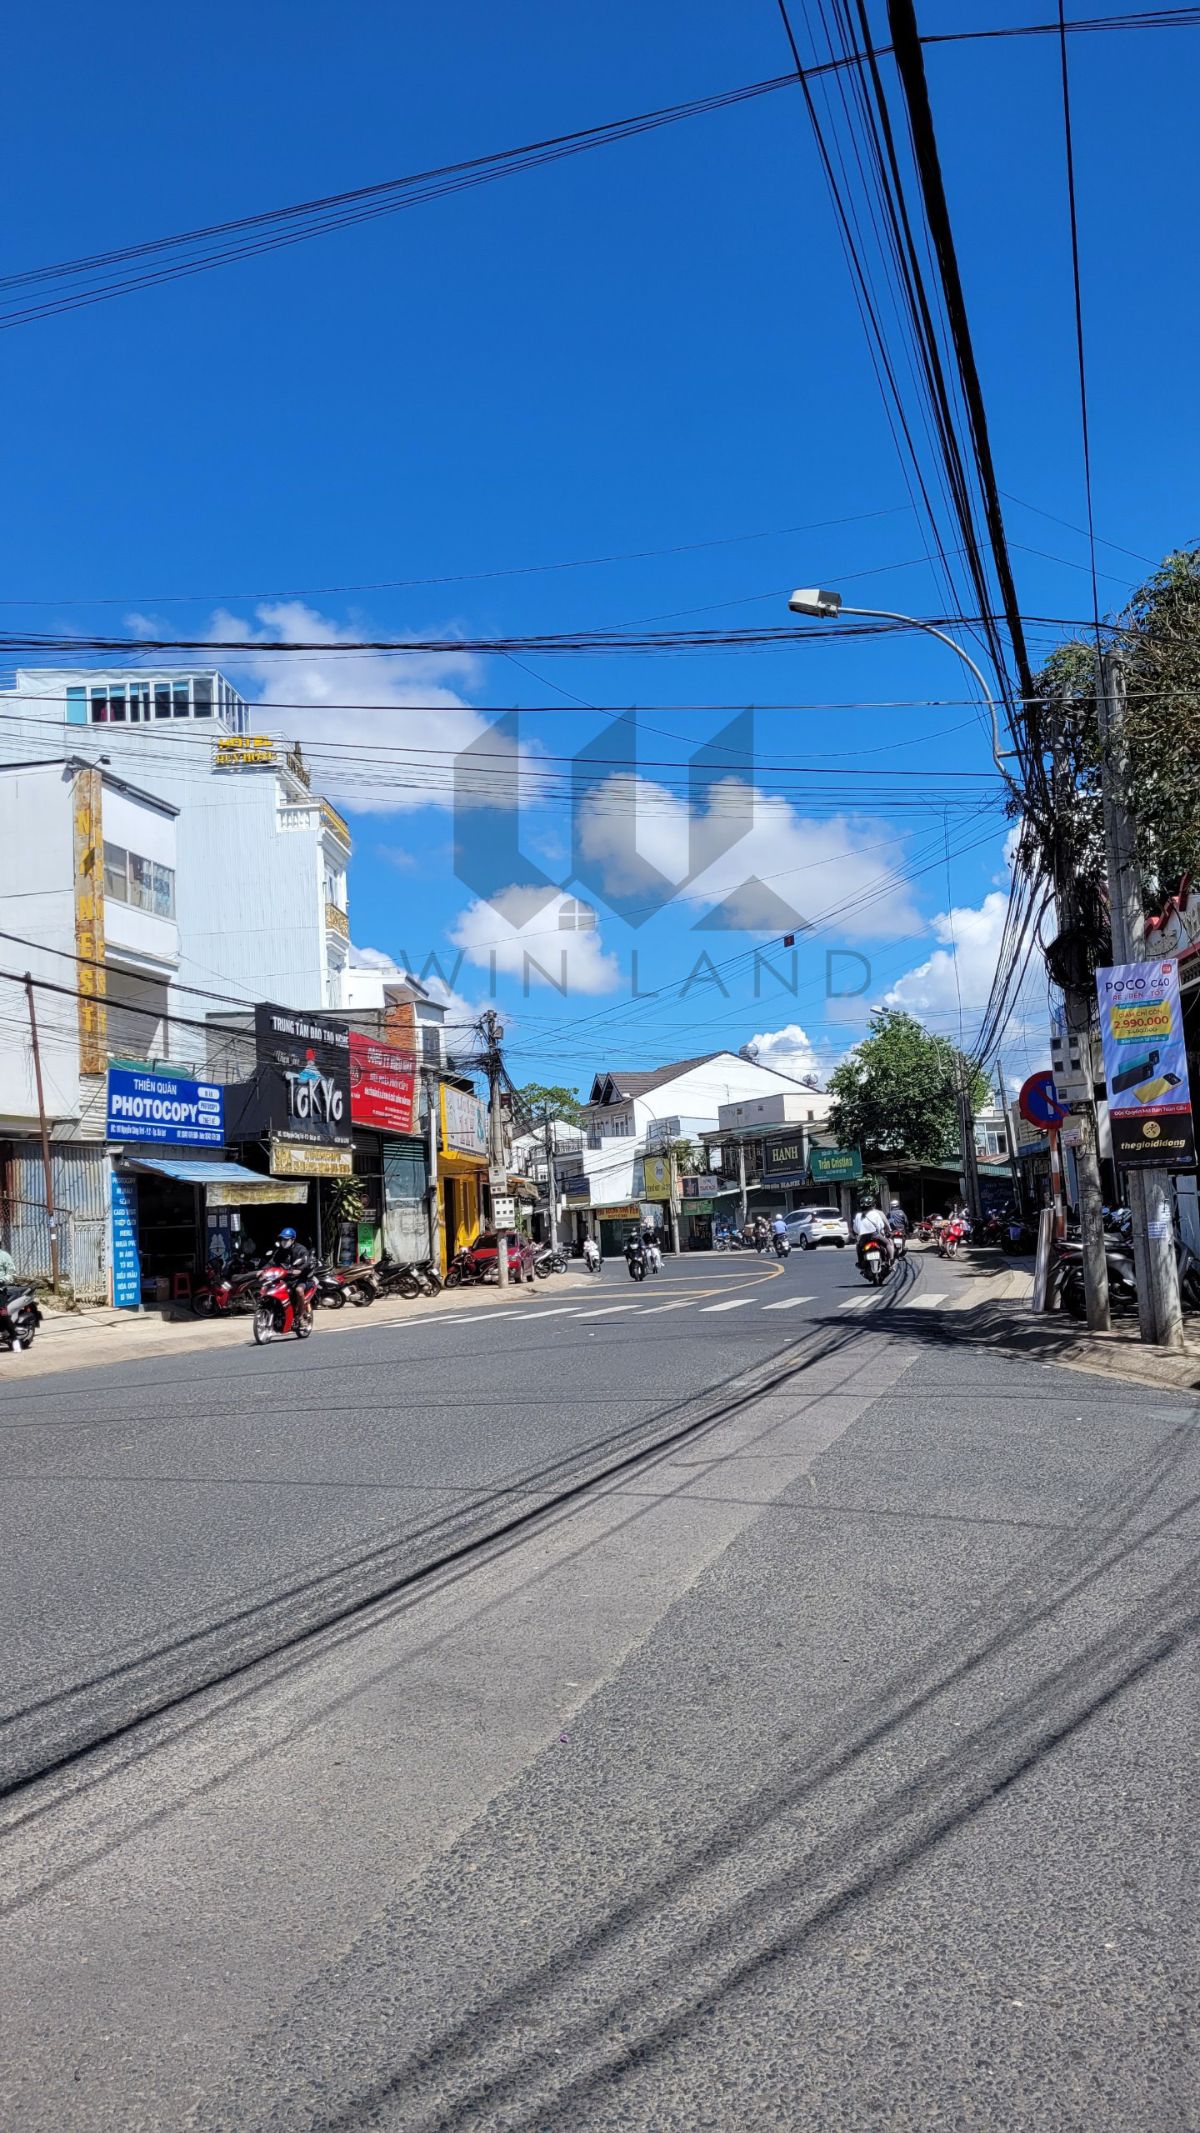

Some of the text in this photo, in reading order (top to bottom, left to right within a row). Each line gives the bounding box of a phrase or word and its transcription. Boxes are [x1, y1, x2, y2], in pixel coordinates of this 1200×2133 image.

[217, 736, 273, 749] HOTEL
[1105, 978, 1170, 993] POCO C40
[272, 1016, 294, 1035] TRUNG
[295, 1018, 310, 1039] TÂM
[1114, 1016, 1169, 1029] 2.990.000
[133, 1078, 177, 1096] THIÊN QUÂN
[111, 1094, 198, 1123] PHOTOCOPY
[1121, 1139, 1186, 1151] thegioididong
[772, 1146, 799, 1164] HẠNH
